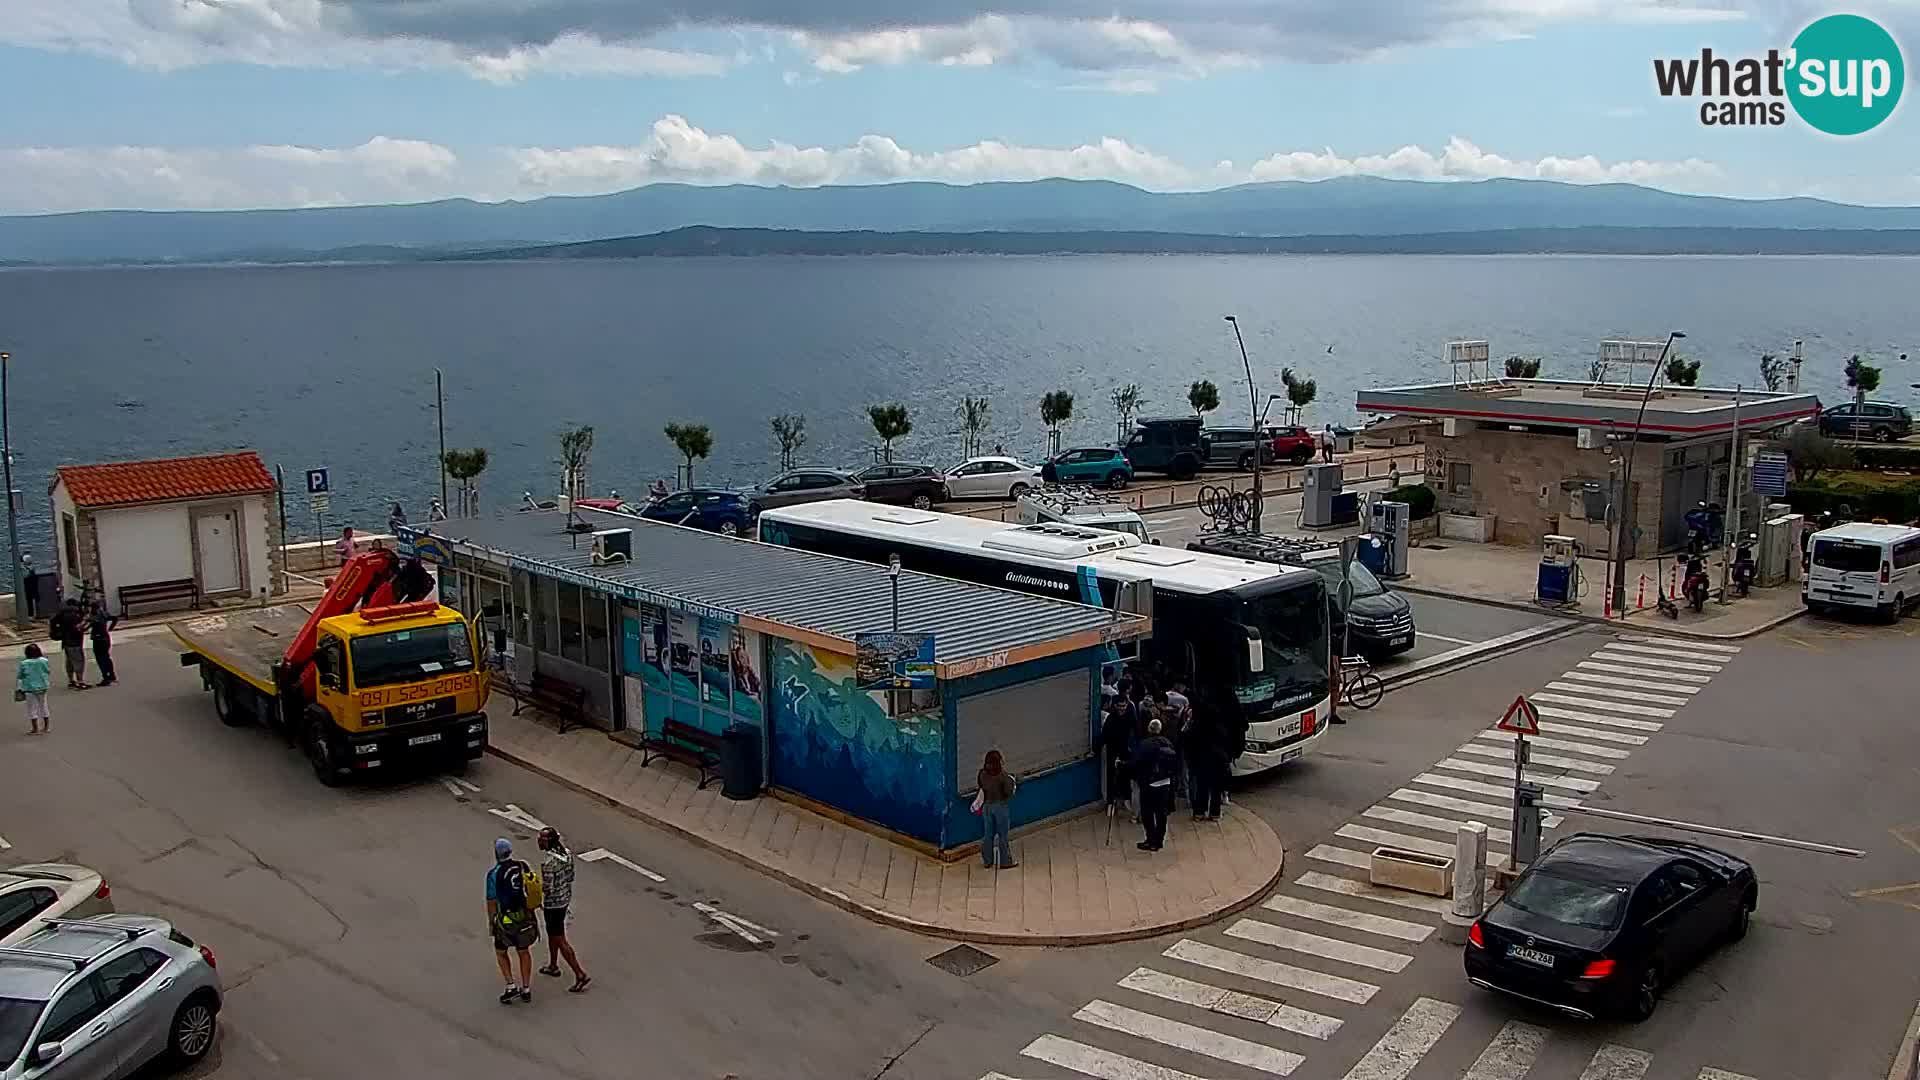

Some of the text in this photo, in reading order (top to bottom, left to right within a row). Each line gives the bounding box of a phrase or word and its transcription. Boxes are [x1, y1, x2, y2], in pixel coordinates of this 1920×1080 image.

[312, 472, 323, 489] P
[650, 594, 681, 609] STATION
[684, 602, 709, 616] TICKET
[709, 607, 735, 623] OFFICE
[361, 690, 392, 708] 091
[400, 685, 429, 702] 525
[407, 703, 436, 713] MAN
[1277, 721, 1301, 737] IVEC
